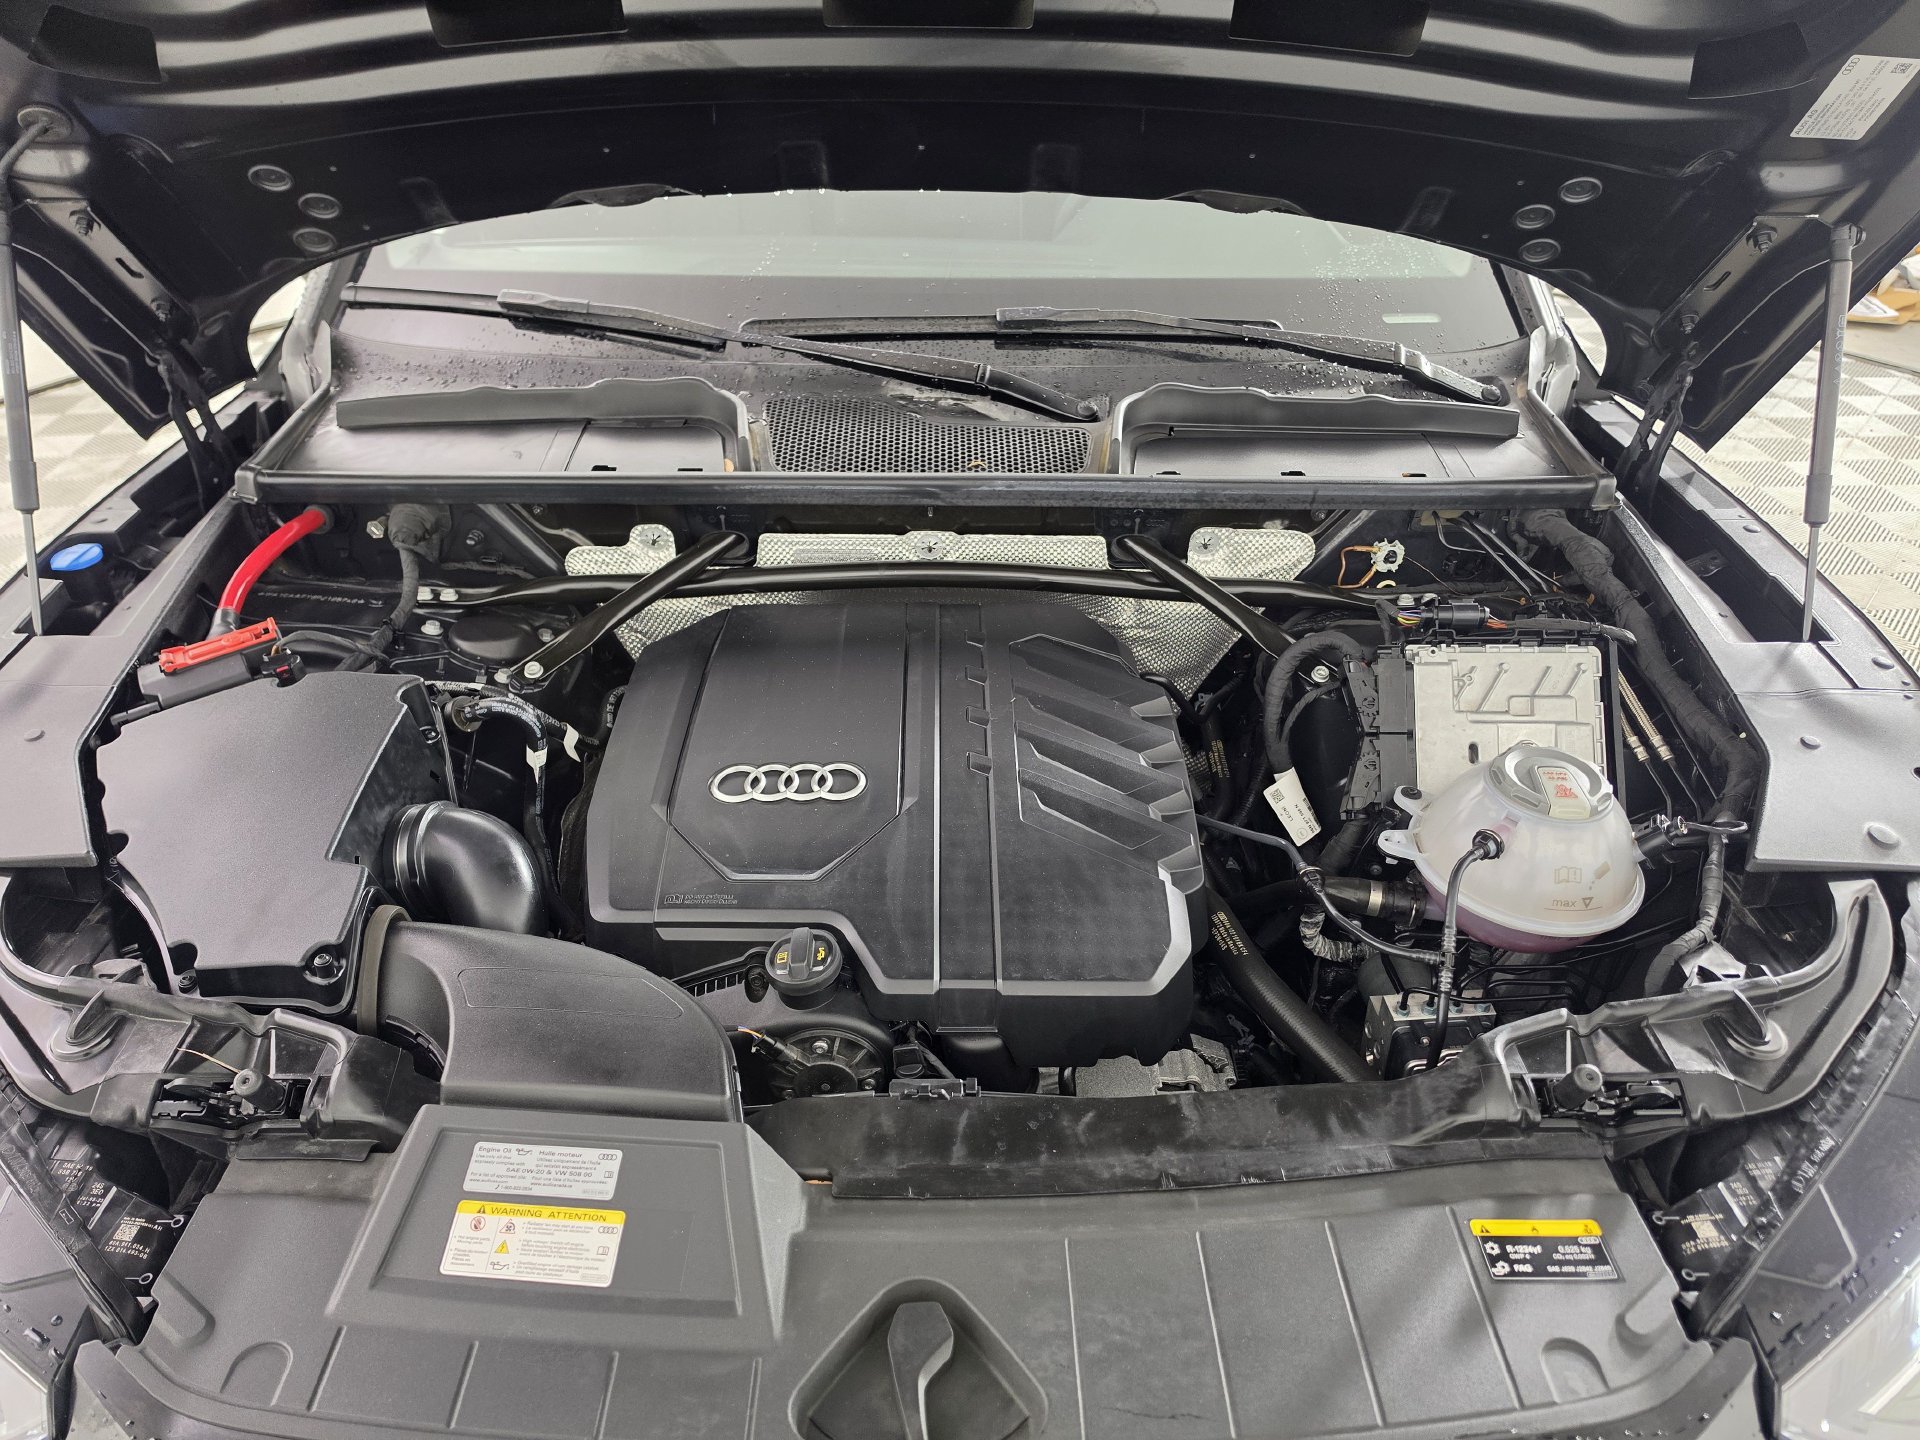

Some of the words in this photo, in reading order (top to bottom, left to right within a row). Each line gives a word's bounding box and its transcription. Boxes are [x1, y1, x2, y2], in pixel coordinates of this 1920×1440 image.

[1795, 118, 1809, 135] AUDI
[1552, 898, 1577, 908] max
[478, 1145, 501, 1154] Engine
[491, 1206, 543, 1218] WARNING
[548, 1211, 607, 1223] ATTENTION
[1505, 1244, 1543, 1255] R-1234yf
[1580, 1245, 1593, 1255] kg
[1513, 1263, 1534, 1273] PAG
